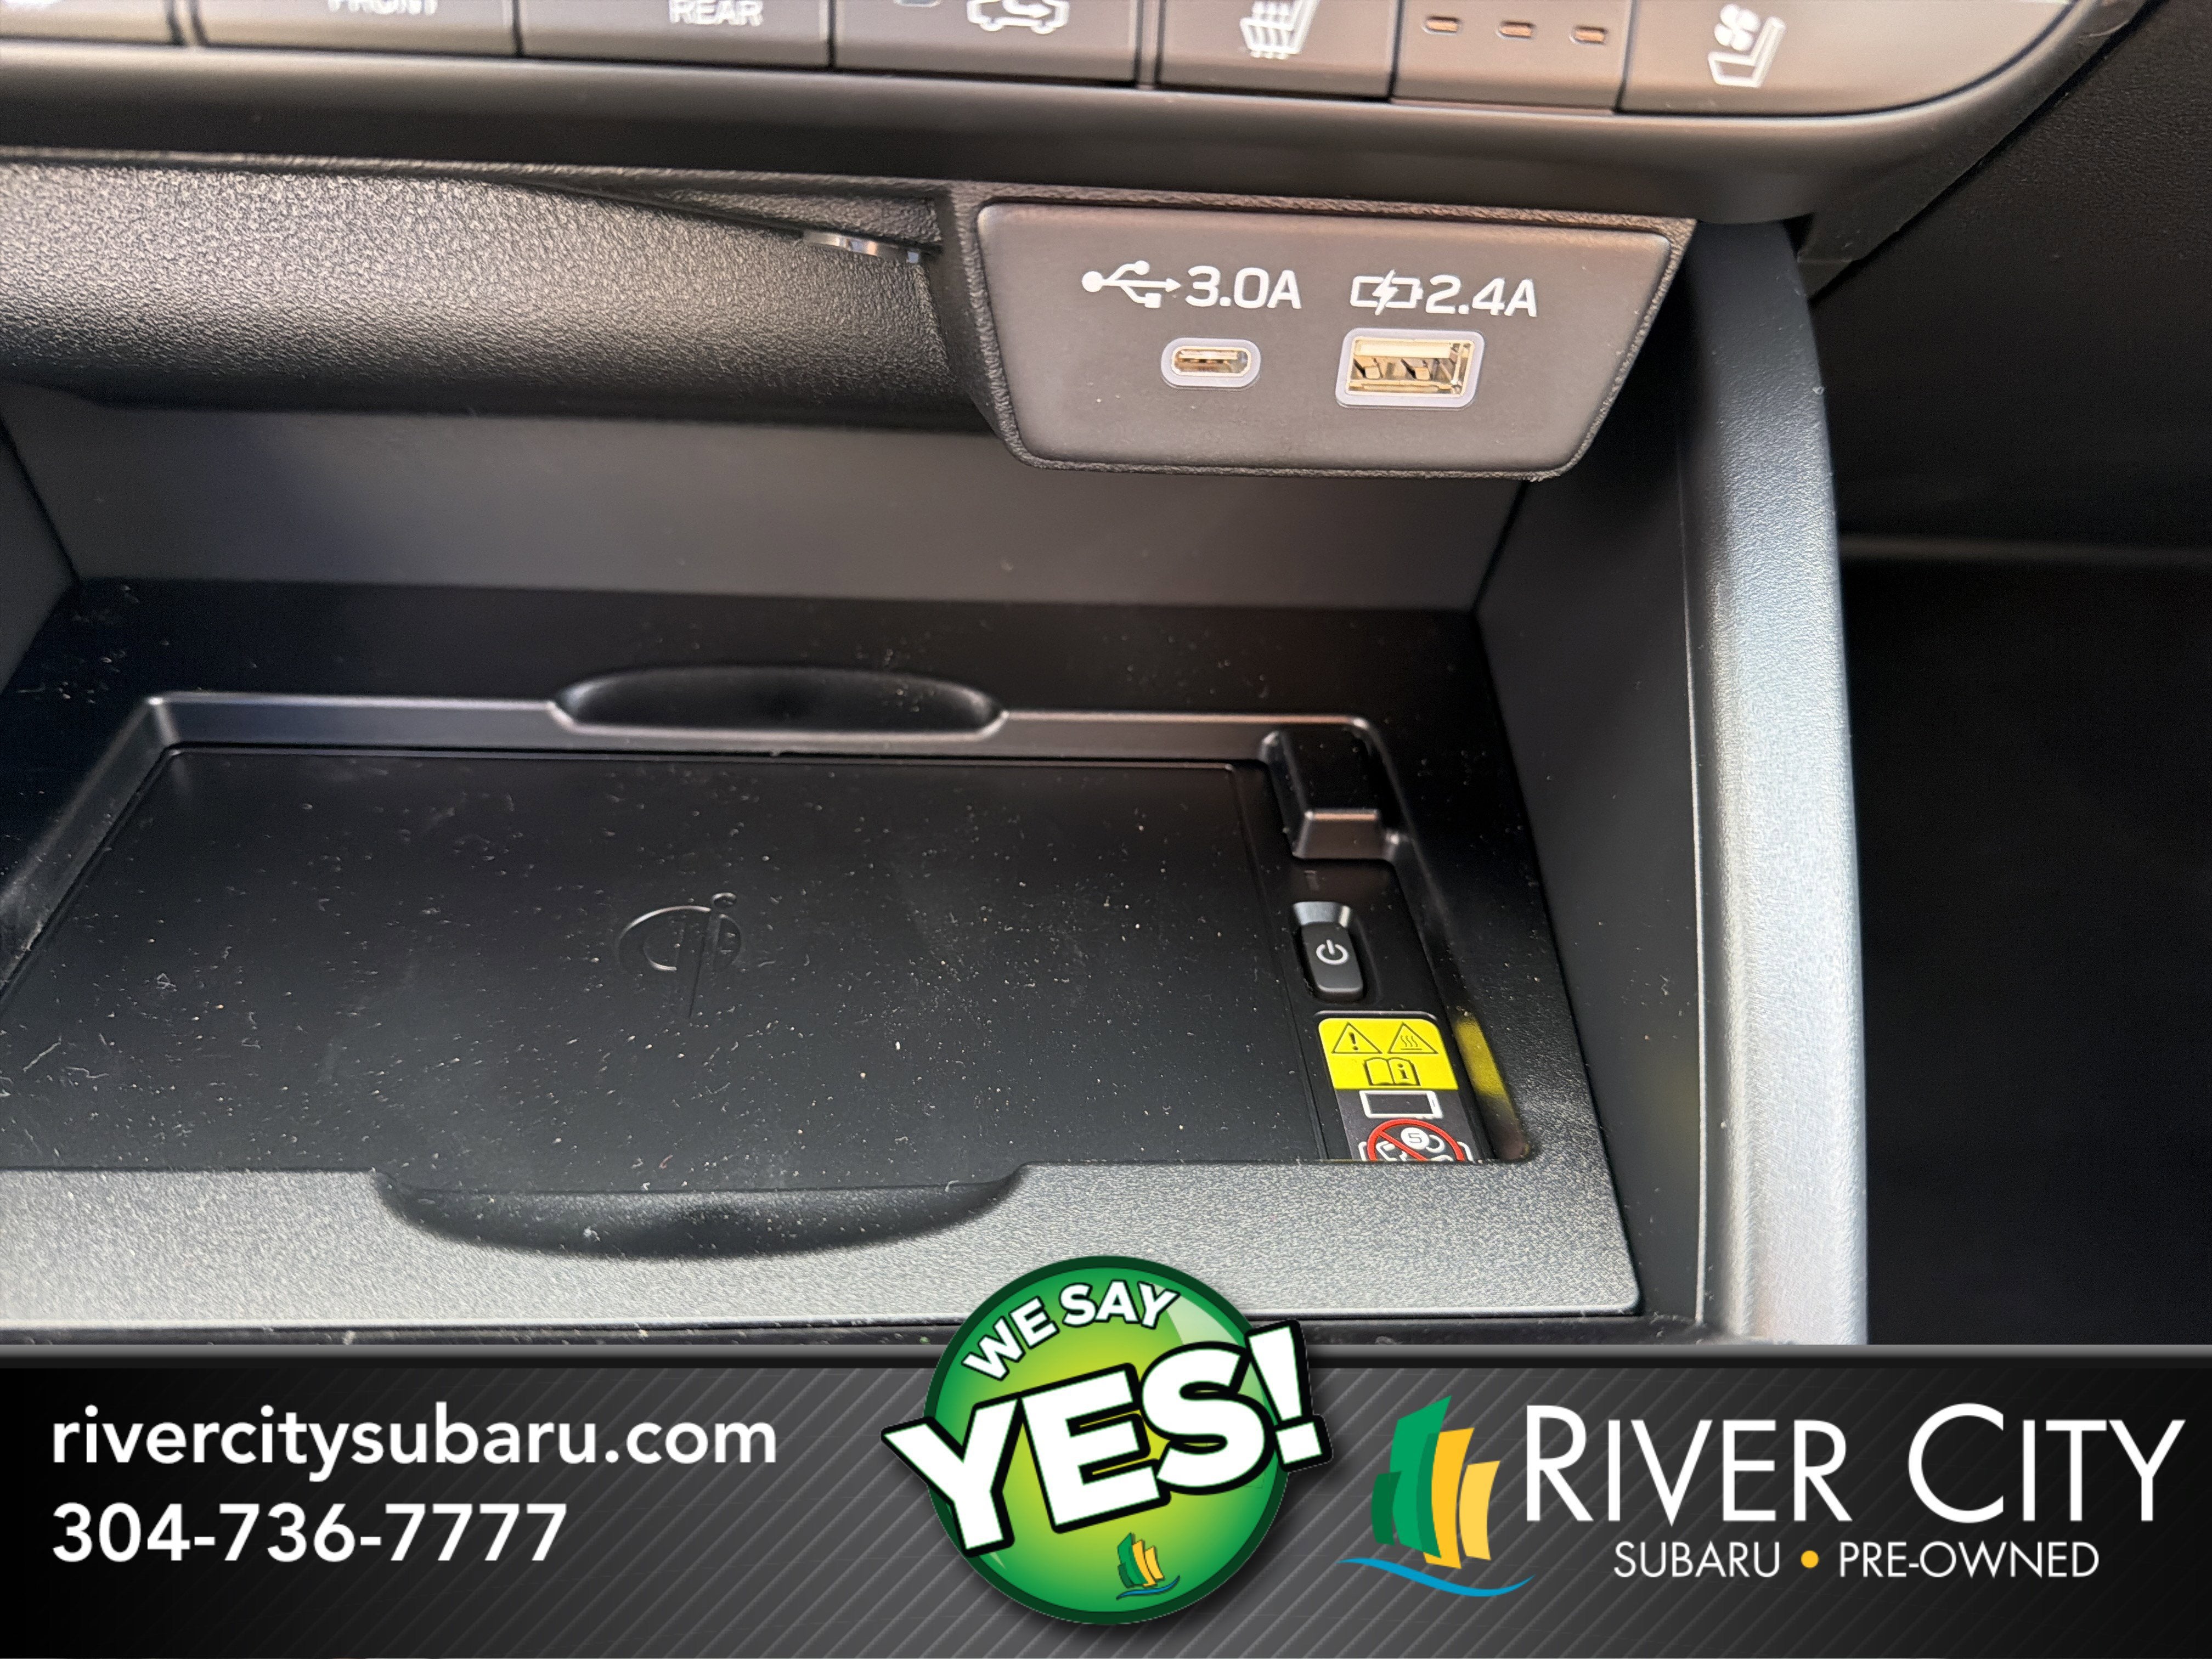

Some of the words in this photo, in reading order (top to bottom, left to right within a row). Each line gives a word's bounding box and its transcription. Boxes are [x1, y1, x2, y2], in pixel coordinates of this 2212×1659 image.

[668, 0, 764, 26] REAR
[1185, 265, 1302, 309] 3.0A
[1425, 274, 1537, 317] 2.4A
